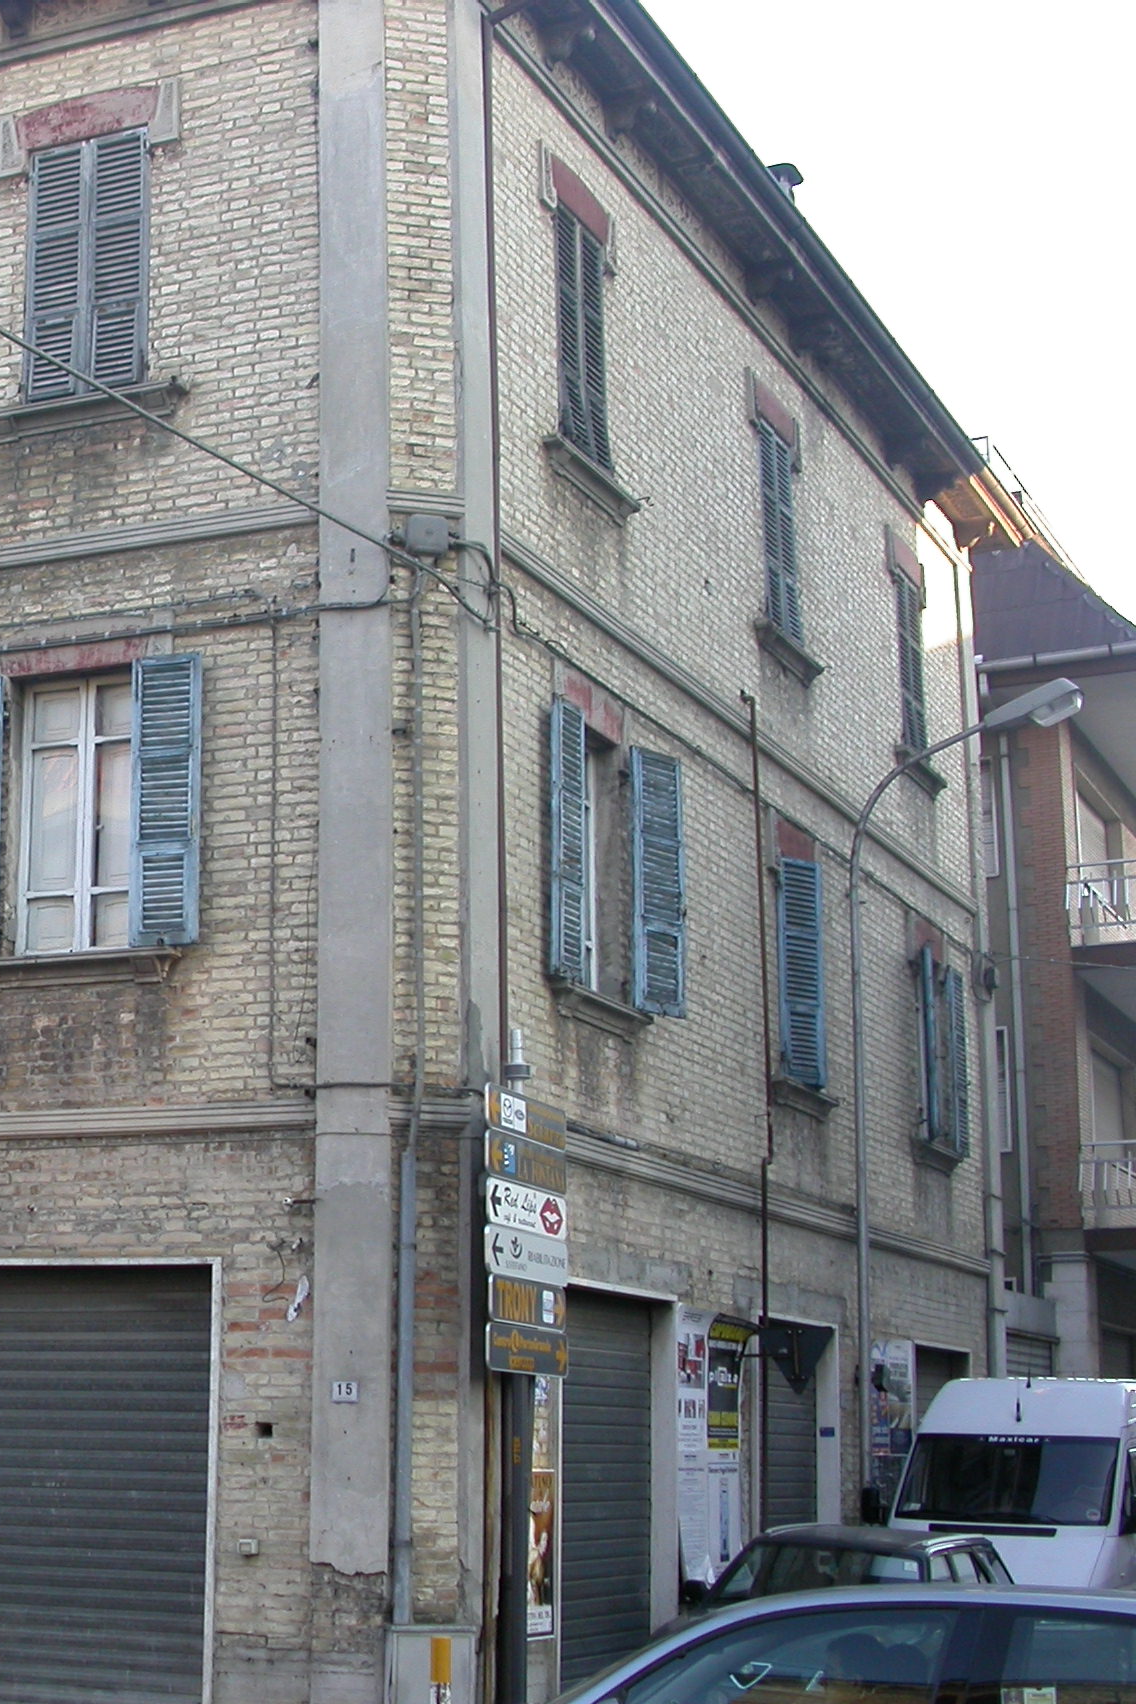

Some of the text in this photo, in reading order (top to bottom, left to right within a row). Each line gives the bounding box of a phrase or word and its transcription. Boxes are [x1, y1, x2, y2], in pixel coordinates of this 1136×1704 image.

[504, 1187, 519, 1208] Red
[496, 1279, 537, 1323] TRONY
[336, 1383, 353, 1397] 15
[988, 1435, 1040, 1443] Maxicar
